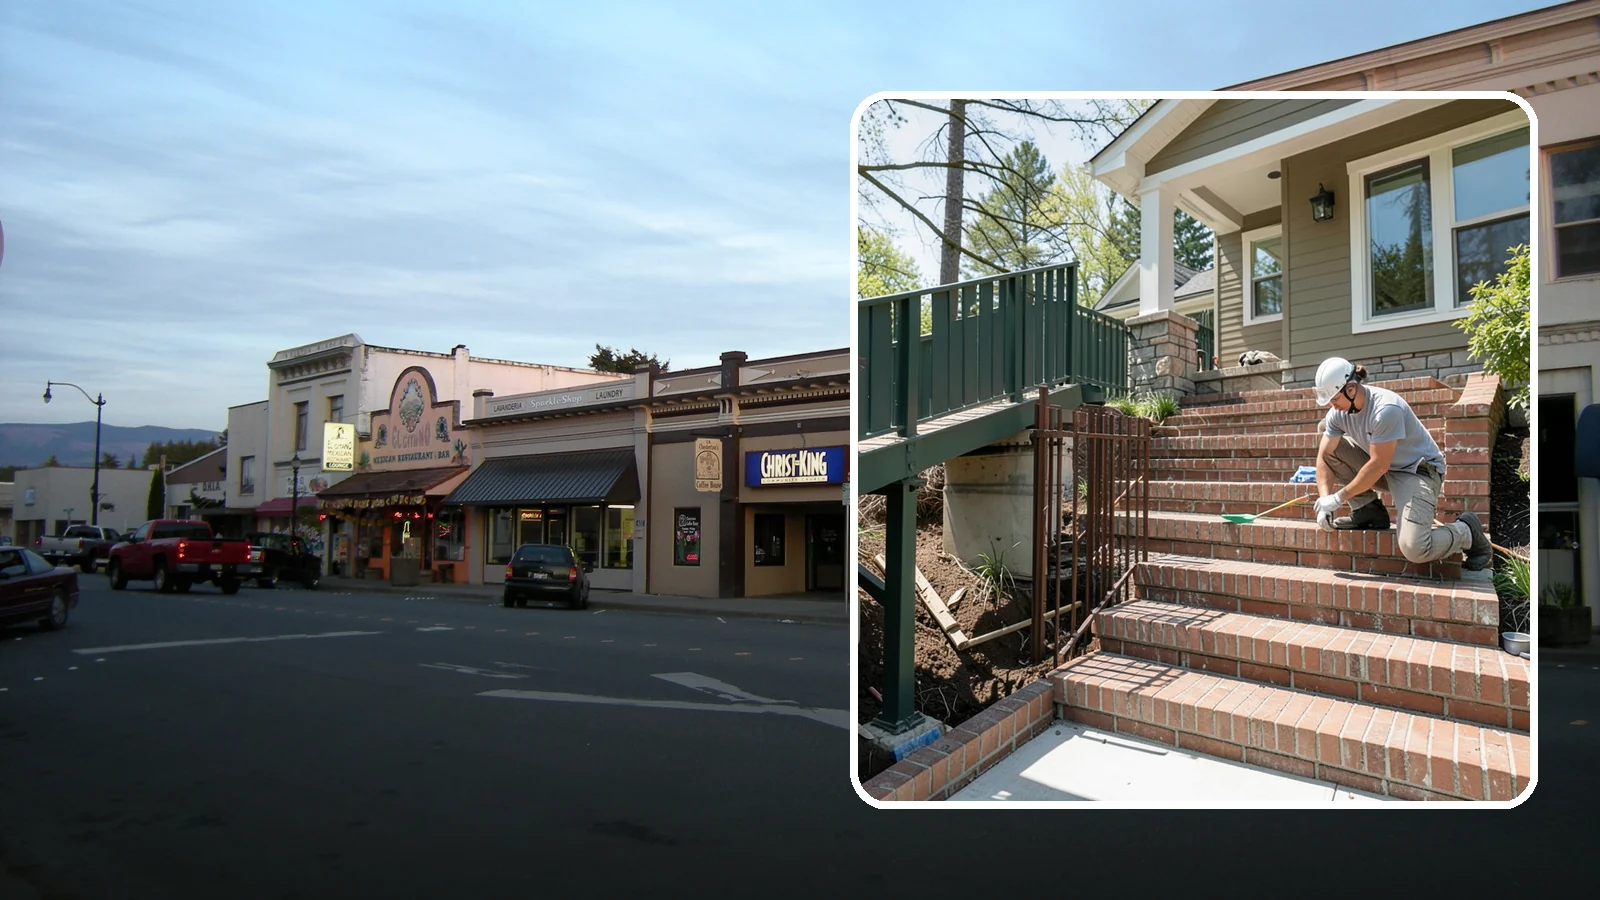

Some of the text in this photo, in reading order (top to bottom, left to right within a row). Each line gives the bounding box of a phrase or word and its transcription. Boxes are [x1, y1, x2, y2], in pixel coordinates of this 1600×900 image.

[595, 389, 624, 400] LAUNDRY
[493, 402, 523, 412] LAVANDERIA
[531, 394, 582, 409] Sparkle Shop
[373, 454, 396, 464] MEXICAN
[397, 451, 433, 462] RESTAURANT
[438, 450, 450, 459] BAR
